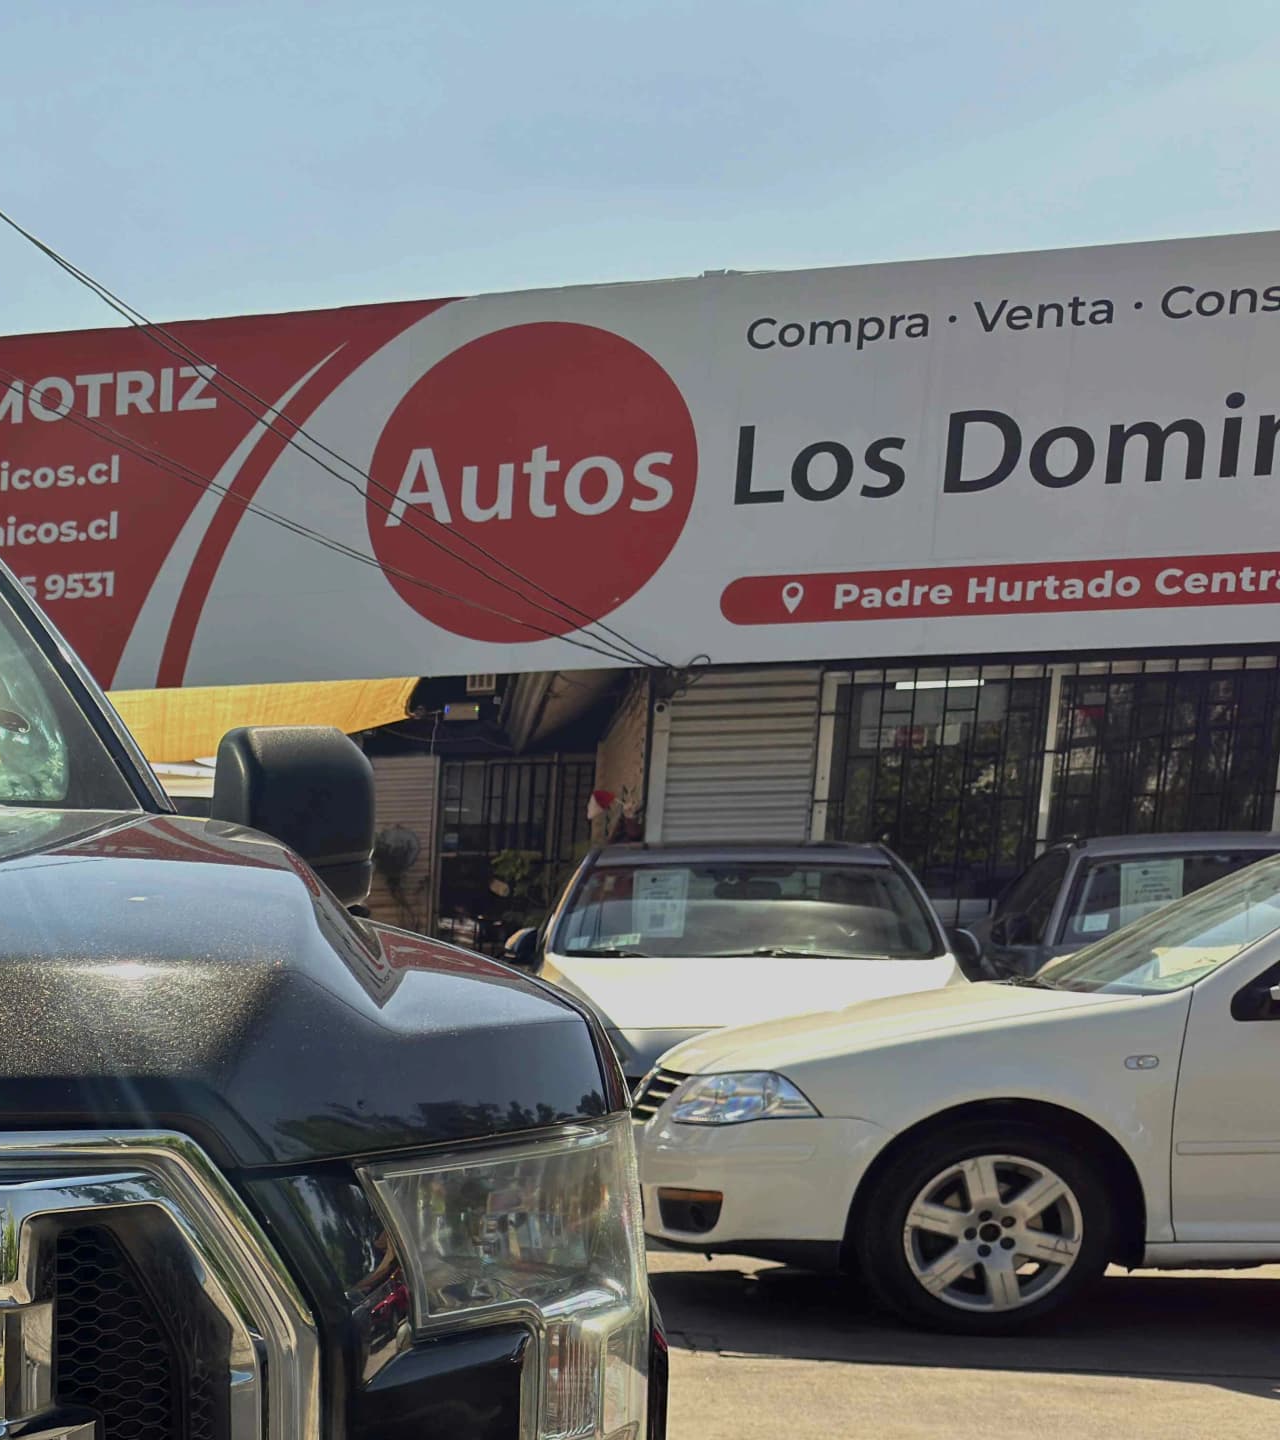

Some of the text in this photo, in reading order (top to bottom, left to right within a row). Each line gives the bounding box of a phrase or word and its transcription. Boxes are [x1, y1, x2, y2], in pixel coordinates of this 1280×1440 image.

[745, 311, 931, 351] Compra
[973, 296, 1115, 333] Venta
[384, 445, 674, 527] Autos
[733, 424, 907, 505] Los
[44, 571, 115, 601] 9531
[833, 566, 1280, 610] Padre Hurtado Centr
